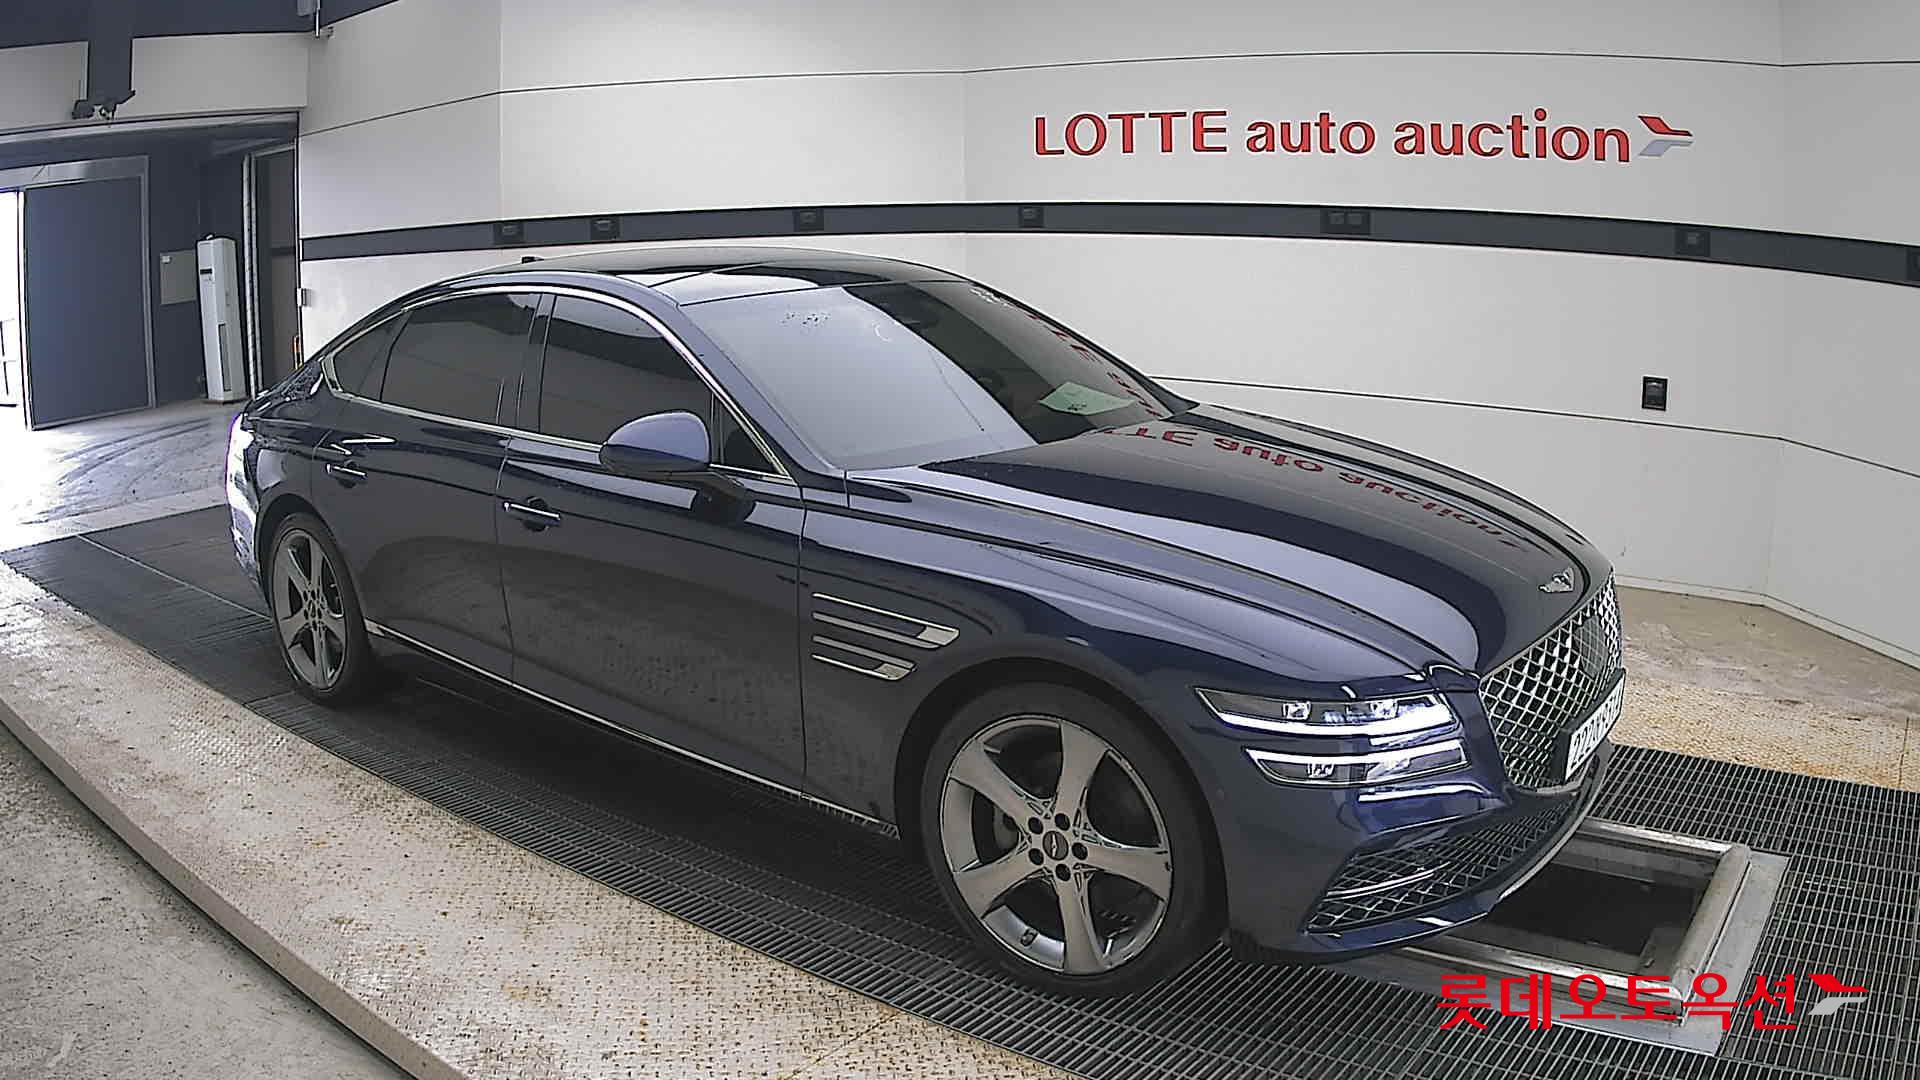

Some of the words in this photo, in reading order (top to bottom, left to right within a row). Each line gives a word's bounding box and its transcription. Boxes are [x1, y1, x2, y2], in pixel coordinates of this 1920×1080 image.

[1035, 111, 1227, 156] LOTTE
[1246, 112, 1376, 154] auto
[1394, 108, 1630, 162] auction
